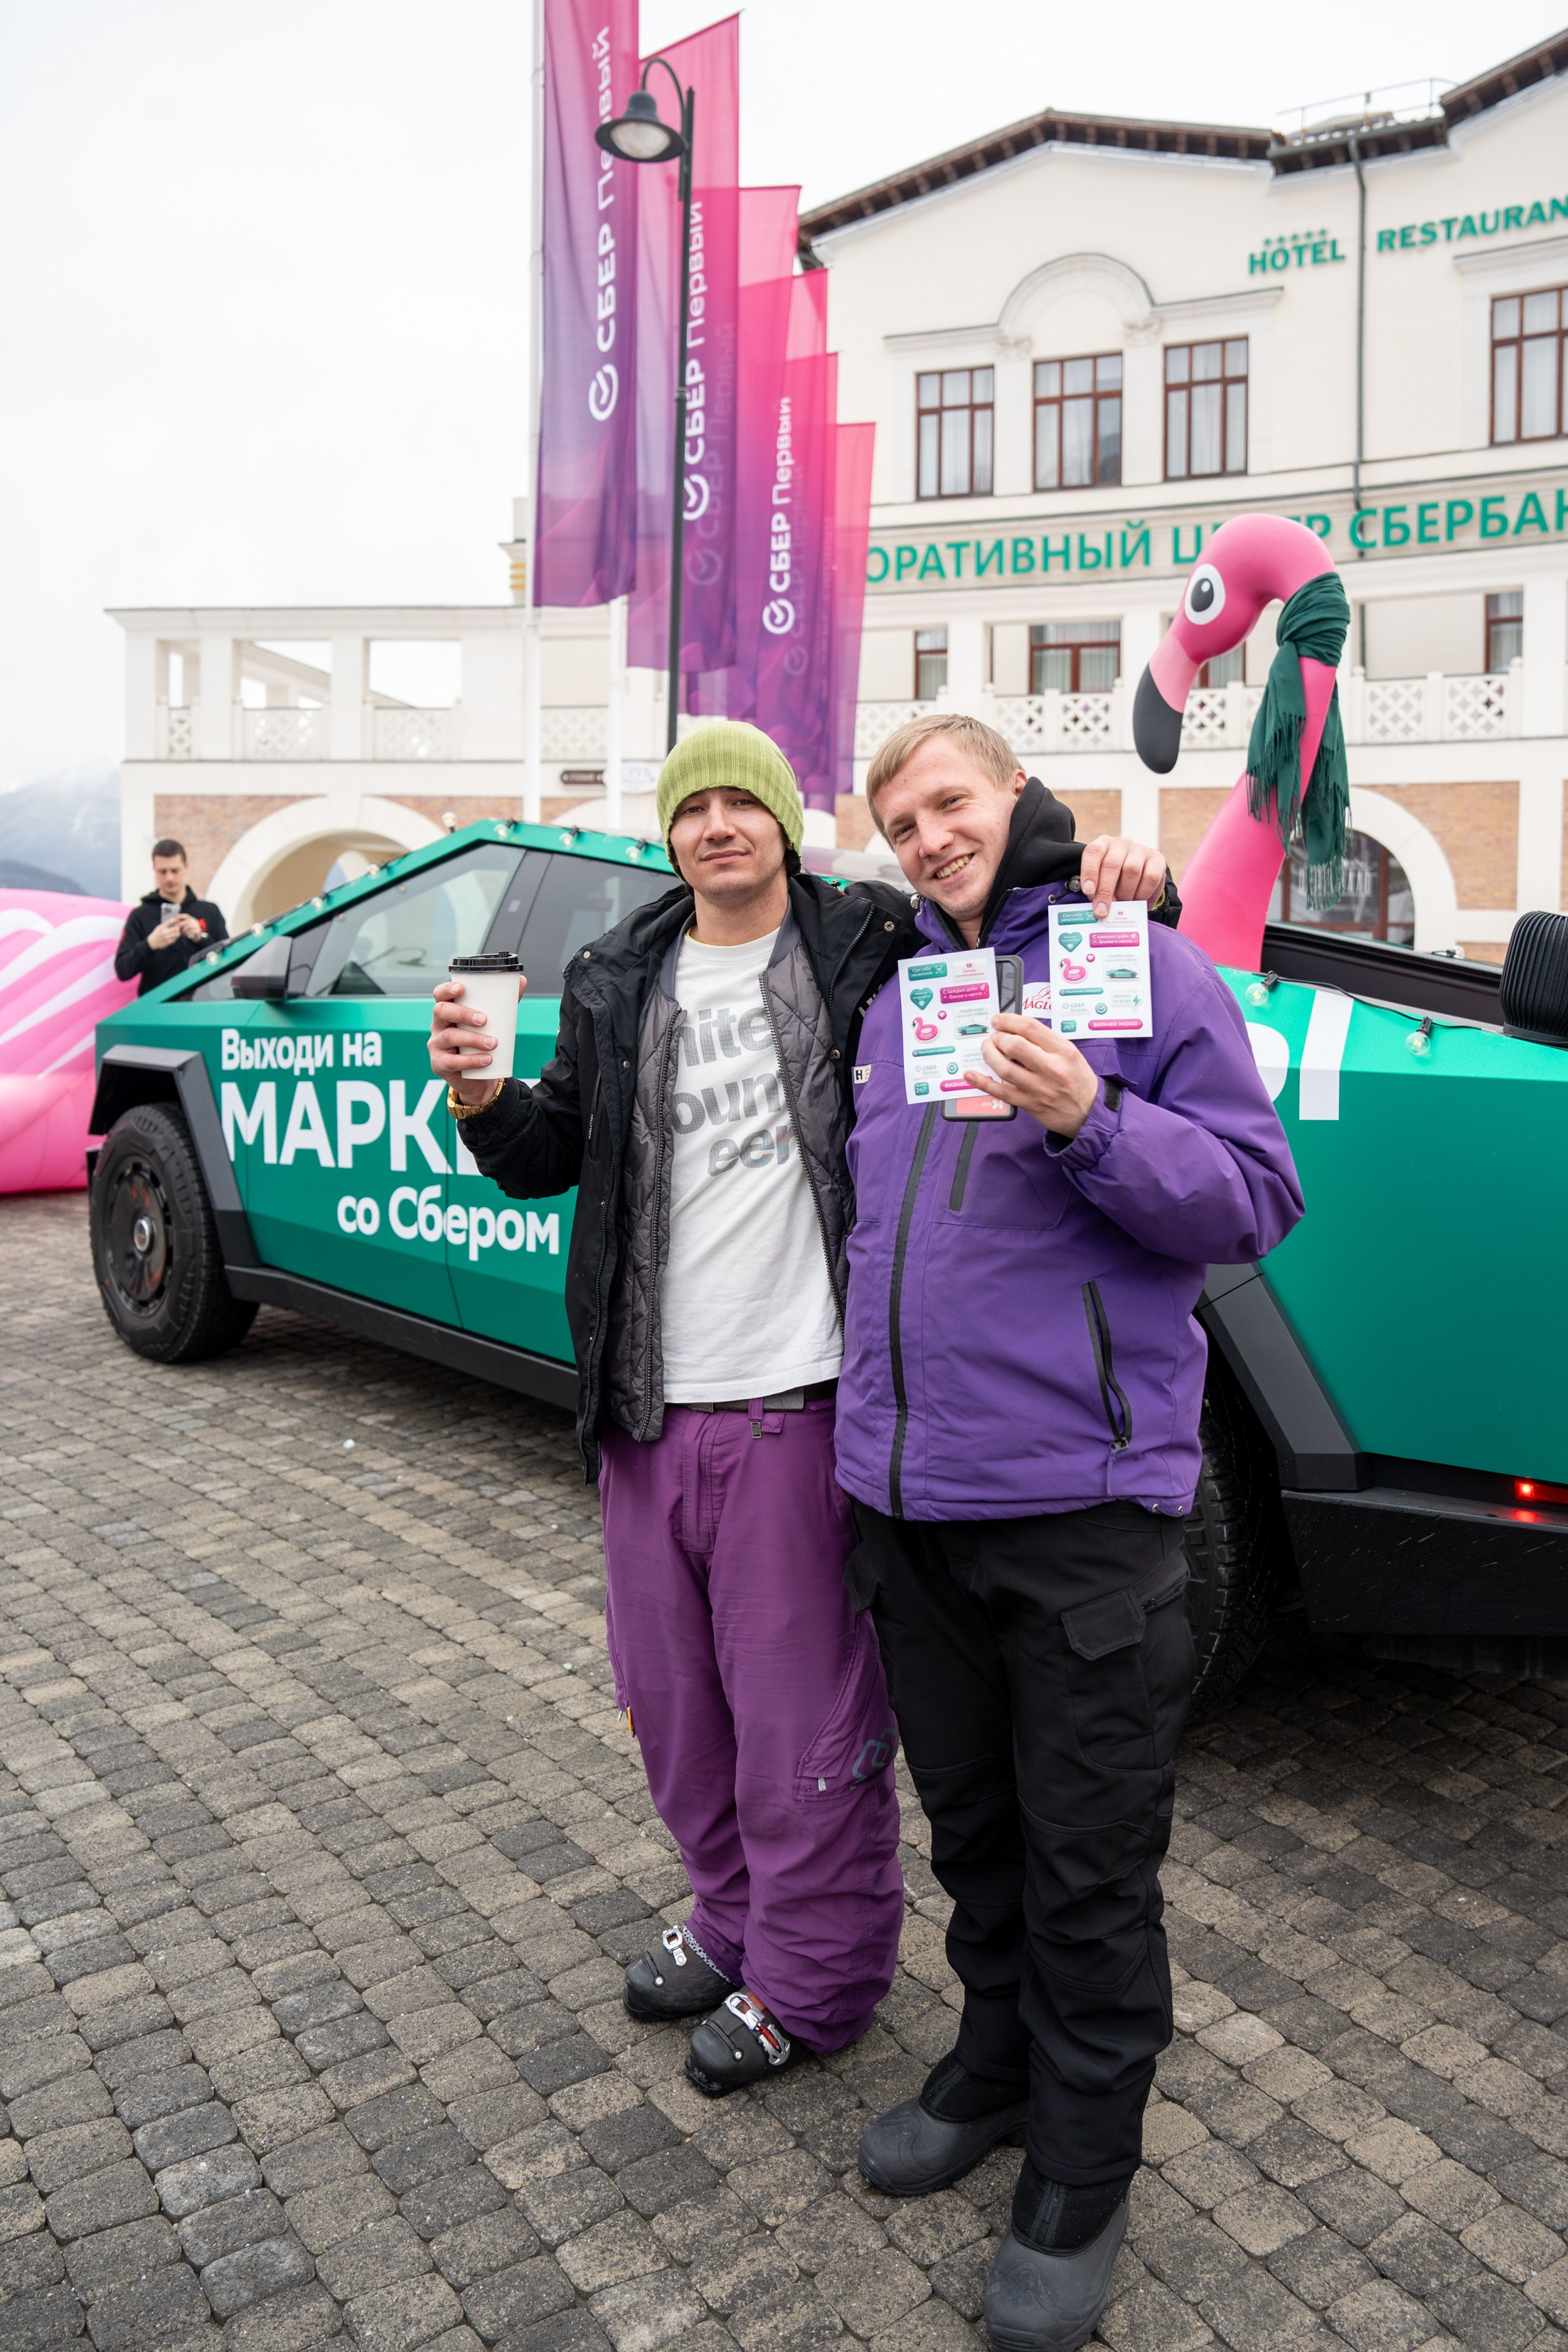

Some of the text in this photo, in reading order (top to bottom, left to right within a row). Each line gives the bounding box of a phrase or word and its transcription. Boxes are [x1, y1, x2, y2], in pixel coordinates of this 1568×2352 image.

[592, 26, 616, 353] СБЕР Певый
[1377, 195, 1568, 252] RESTAURAN
[1249, 239, 1345, 275] HOTEL
[684, 201, 708, 465] СБЕР Первый
[770, 397, 796, 593] СБЕР Первый
[221, 1028, 382, 1076] Выходи на
[220, 1078, 540, 1176] МАРК
[672, 1068, 786, 1135] oun
[337, 1183, 560, 1262] со Сбером
